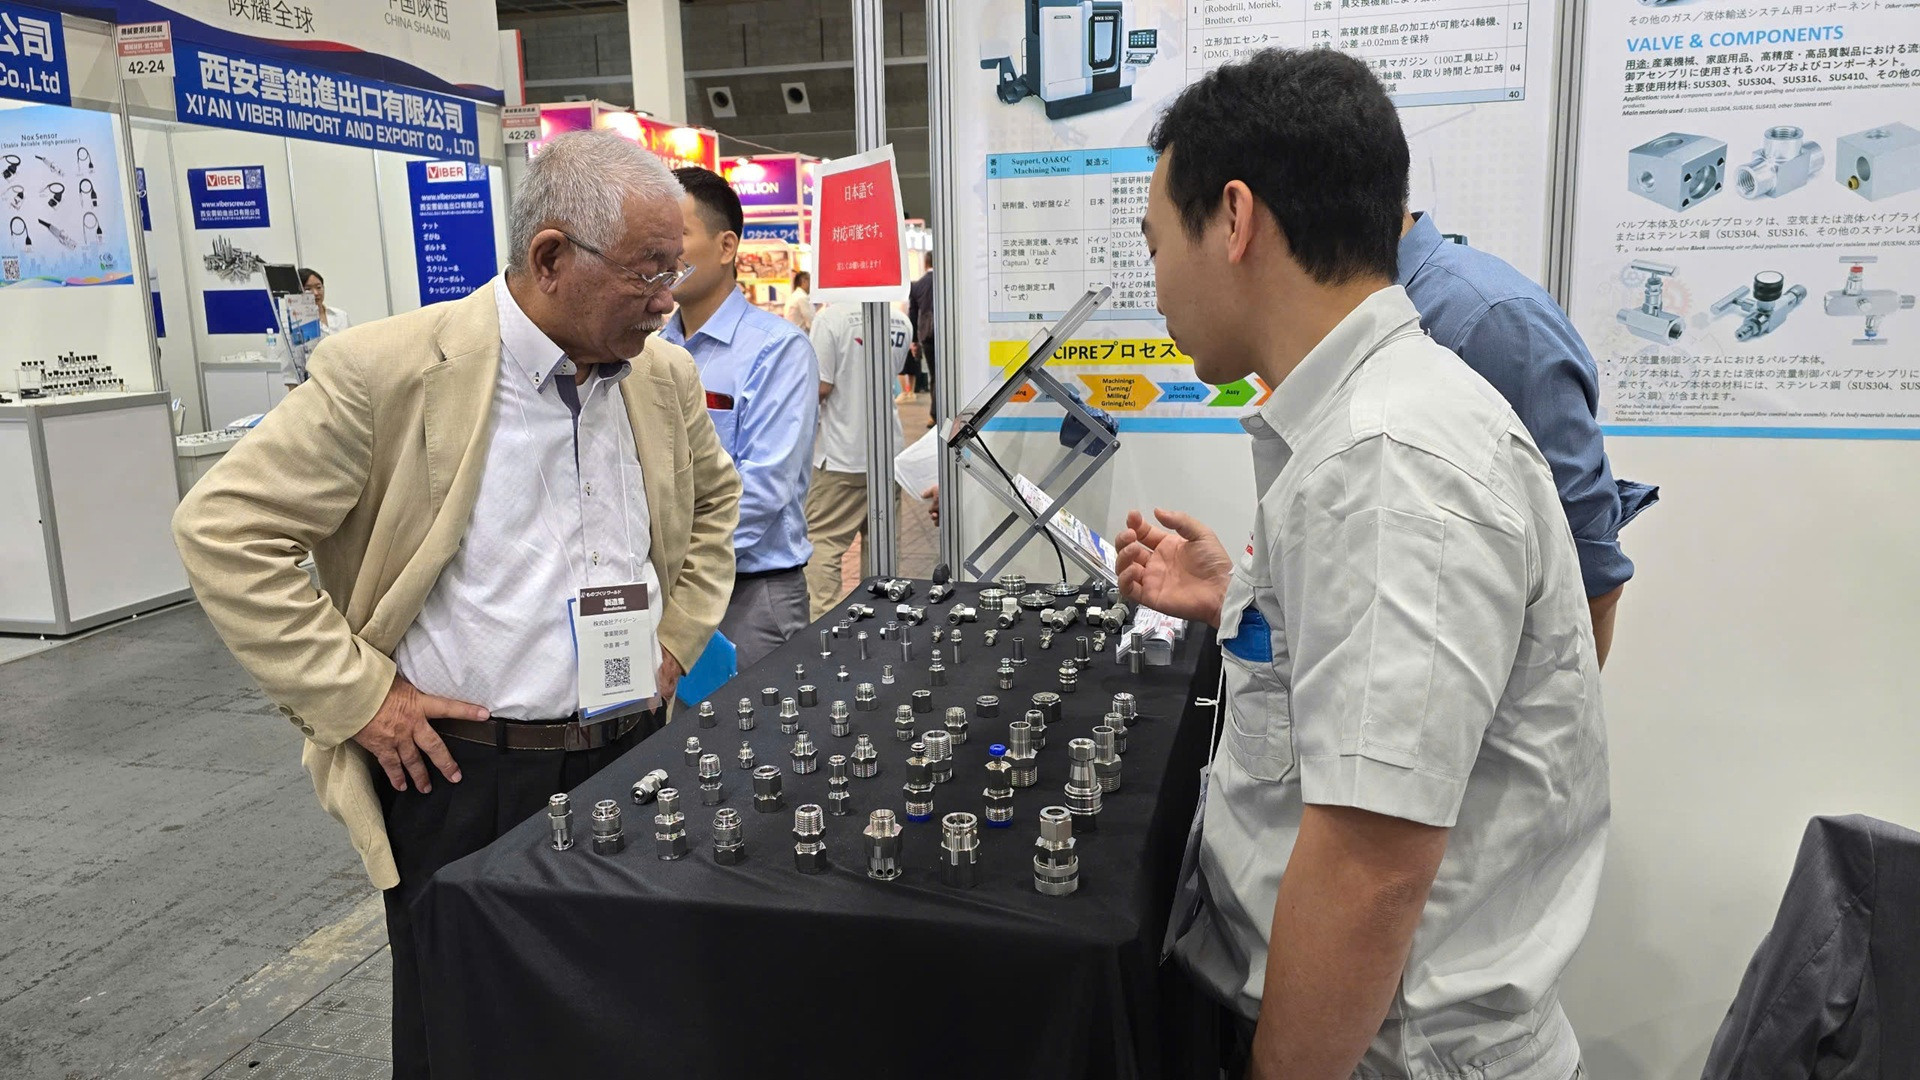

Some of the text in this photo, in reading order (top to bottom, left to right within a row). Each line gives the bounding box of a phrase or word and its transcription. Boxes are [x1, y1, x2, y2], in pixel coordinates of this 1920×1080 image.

[1194, 6, 1197, 14] 1
[1204, 2, 1246, 14] (Robodrill,
[1313, 1, 1332, 10] 台湾
[1204, 14, 1252, 25] Brother, etc)
[384, 12, 451, 41] CHINA SHAANXI
[1512, 22, 1523, 30] 12
[0, 12, 54, 62] 公司
[1204, 33, 1279, 47] 立形加工センター
[1627, 25, 1844, 52] VALVE & COMPONENTS
[1204, 50, 1230, 60] (DMG,
[1652, 43, 1920, 68] 産業機械、家庭用品、高精度・高品質製品における流
[128, 60, 165, 74] 42-24
[1510, 64, 1521, 72] 04
[1509, 90, 1520, 99] 40
[186, 93, 233, 120] XI'AN
[236, 101, 284, 128] VIBER
[286, 109, 341, 136] IMPORT
[345, 120, 373, 141] AND
[376, 124, 424, 149] EXPORT
[508, 130, 536, 140] 42-26
[1011, 156, 1072, 166] Support, QA&QC
[1085, 158, 1109, 167] 製造元
[428, 166, 464, 179] VIBER
[1014, 167, 1049, 175] Machining
[207, 174, 241, 187] VIBER
[733, 182, 779, 195] AVILION
[844, 182, 874, 201] 日本語で
[421, 192, 479, 201] www.viberscrew.com
[1090, 198, 1105, 206] 日本
[422, 222, 438, 230] ナット
[832, 222, 883, 243] 対応可能です。
[1616, 225, 1920, 241] またはステンレス鋼（SUS304、SUS316、その他のステンレス
[1088, 236, 1109, 244] ドイツ
[1615, 243, 1629, 253] す。
[1090, 256, 1105, 264] 台湾
[428, 275, 465, 284] アンカーボルト
[1004, 283, 1055, 292] その他測定工具
[1054, 340, 1177, 360] CIPREプロセス
[1105, 385, 1132, 393] (Turning/
[1226, 388, 1240, 396] Assy
